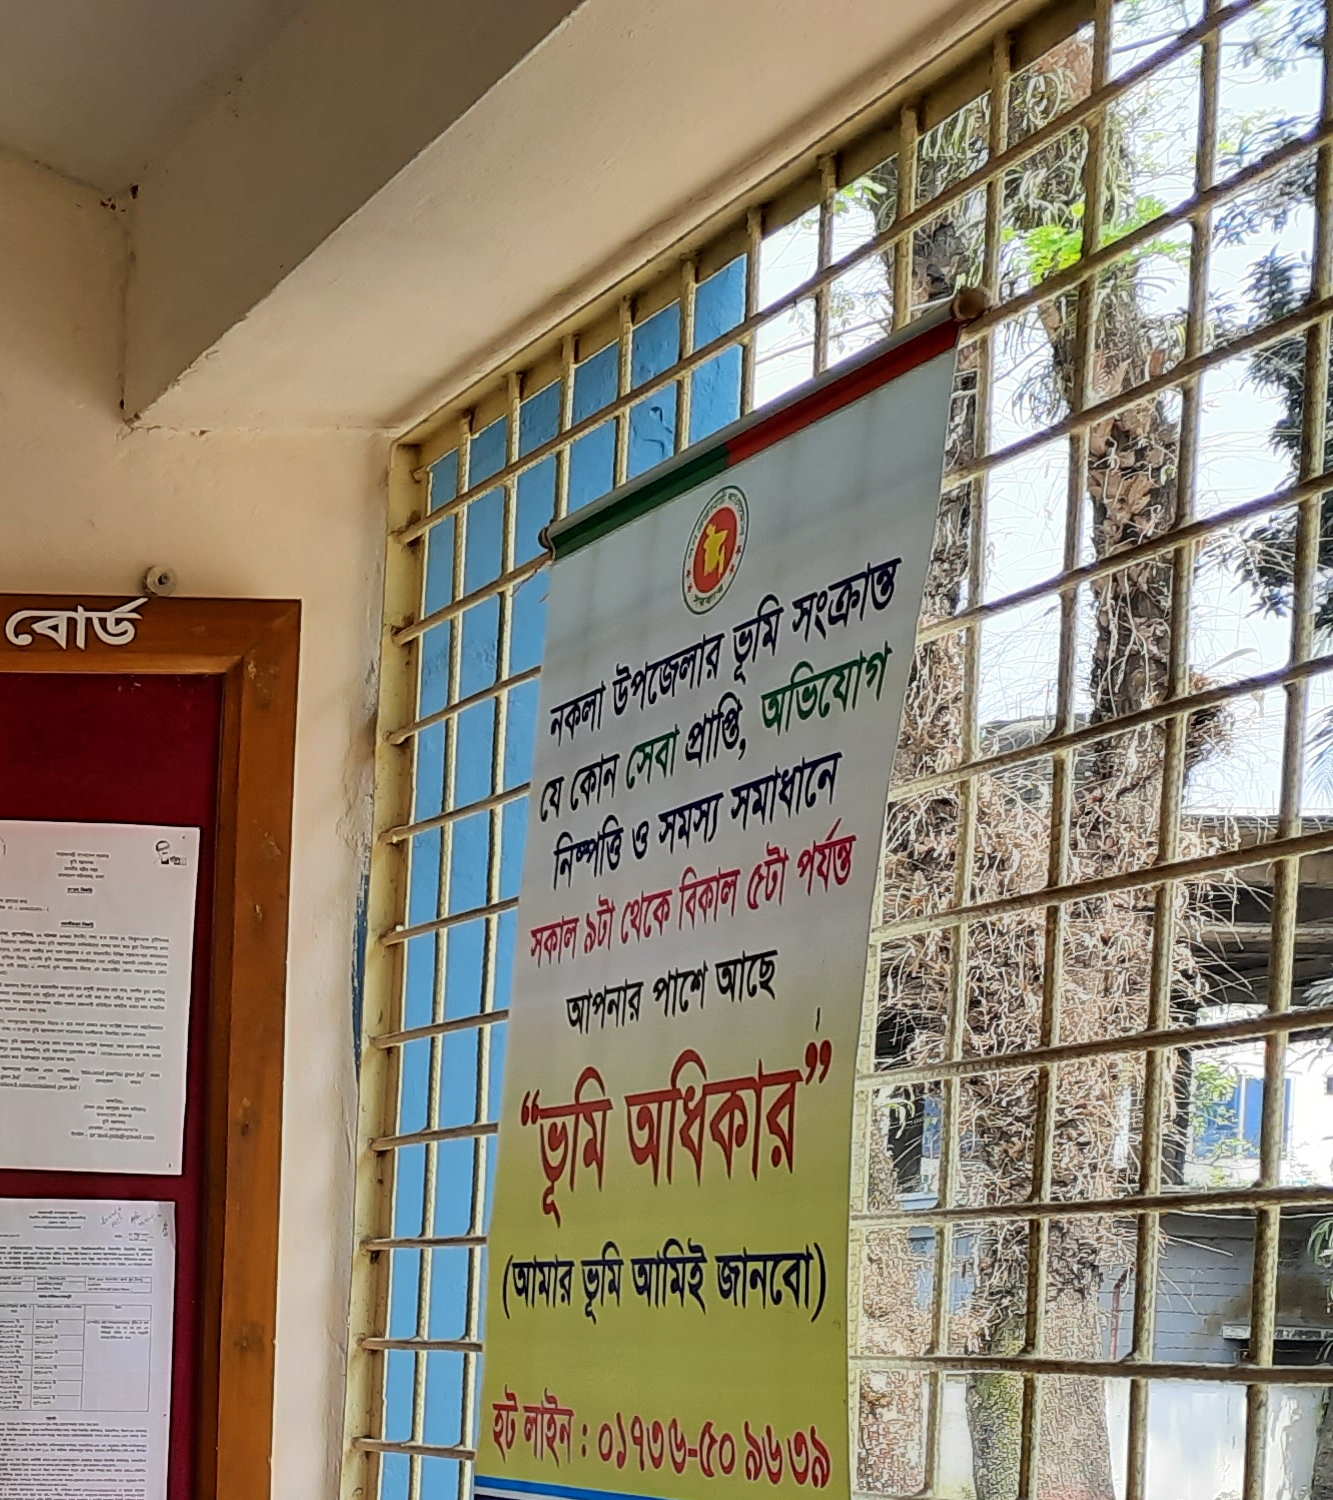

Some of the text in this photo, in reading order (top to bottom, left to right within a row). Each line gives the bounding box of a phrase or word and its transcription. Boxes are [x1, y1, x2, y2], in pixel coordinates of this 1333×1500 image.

[6, 597, 149, 650] বোর্ড
[550, 557, 902, 746] নকলা উপজেলার ভূমি সংক্রান্ত
[540, 776, 564, 822] যে
[571, 753, 619, 811] কোন
[626, 724, 679, 789] সেবা
[761, 640, 893, 736] অভিযোগ
[633, 821, 649, 860] ও
[730, 752, 842, 831] সমাধানে
[530, 818, 857, 967] সকাল ৯টা থেকে বিকাল ৫টা পর্যন্ত
[566, 950, 778, 1034] আপনার পাশে আছে
[580, 1240, 624, 1325] ভূমি
[630, 1238, 708, 1315] আমিই
[492, 1384, 518, 1464] হট
[523, 1388, 575, 1468] লাইন
